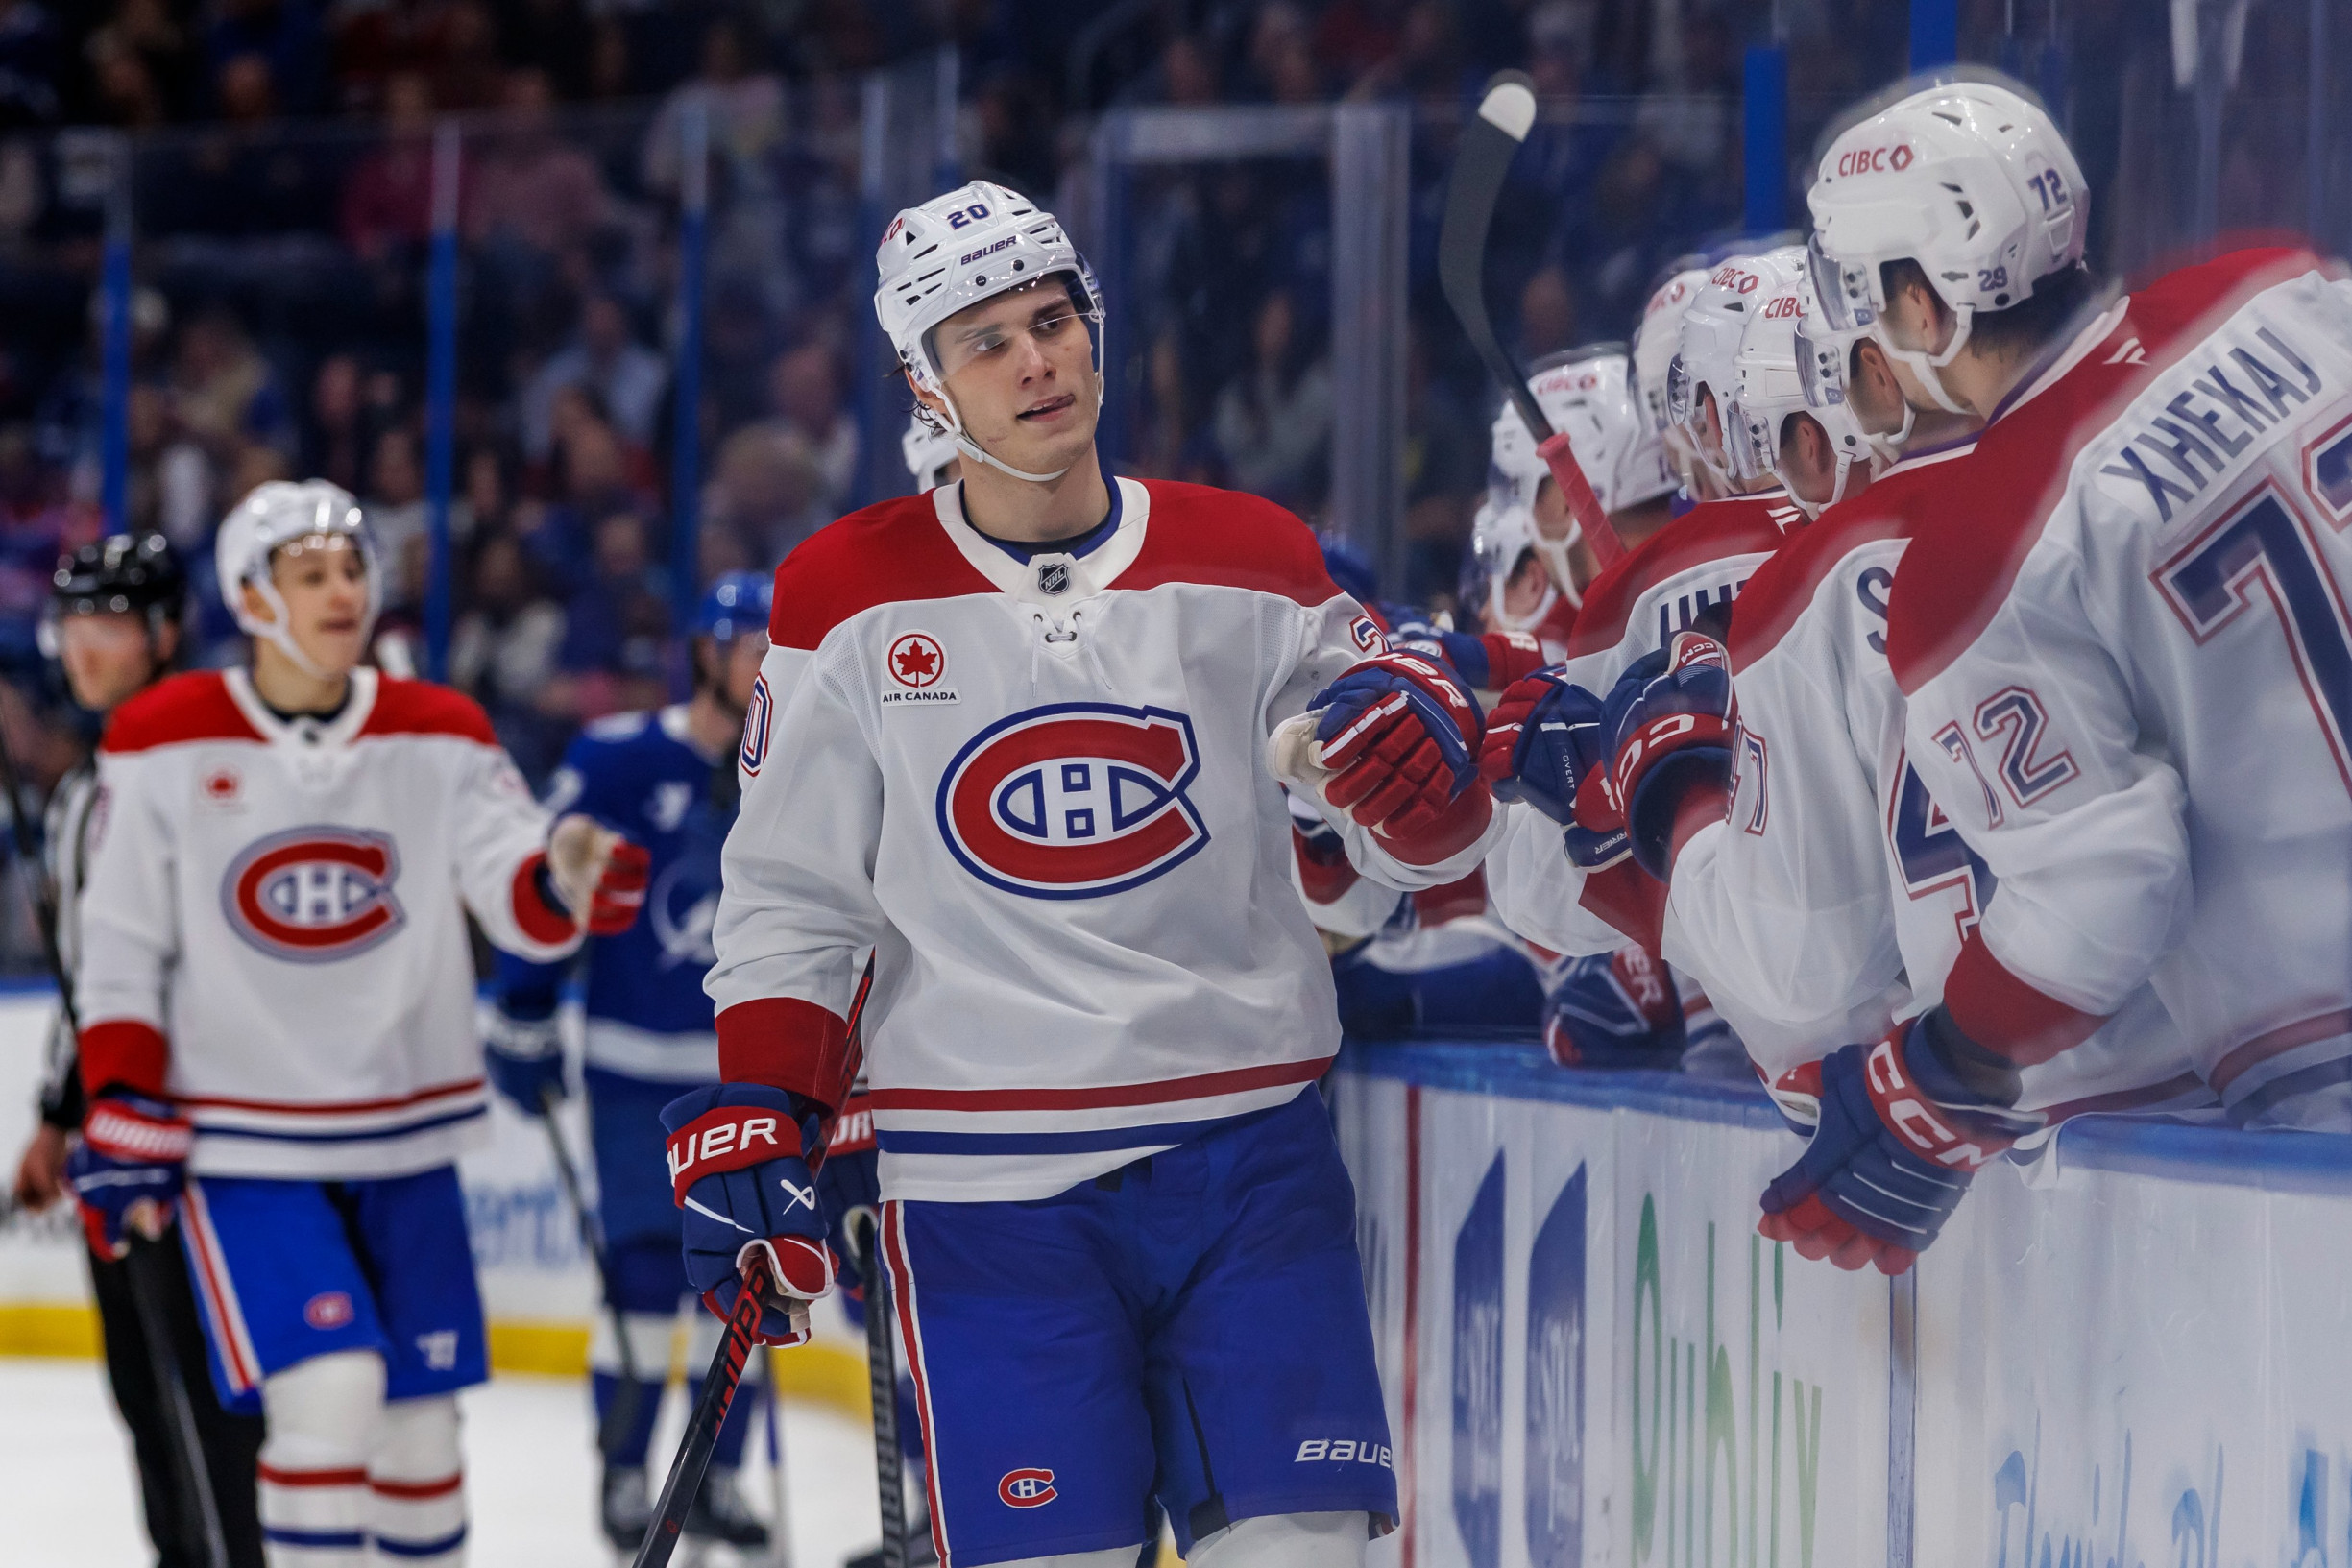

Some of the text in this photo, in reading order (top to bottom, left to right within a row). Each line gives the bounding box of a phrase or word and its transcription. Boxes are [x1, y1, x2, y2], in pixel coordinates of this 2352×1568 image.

[1837, 146, 1886, 178] CIBC
[2026, 167, 2068, 212] 72
[946, 202, 991, 231] 20
[1711, 267, 1745, 289] CIBC
[1977, 265, 2009, 292] 29
[2099, 326, 2322, 524] XHEKAJ
[1044, 568, 1066, 590] NHL
[882, 691, 958, 703] AIR CANADA
[1562, 748, 1576, 790] OVERT
[1932, 685, 2081, 830] 72
[1294, 1439, 1395, 1471] BAUE
